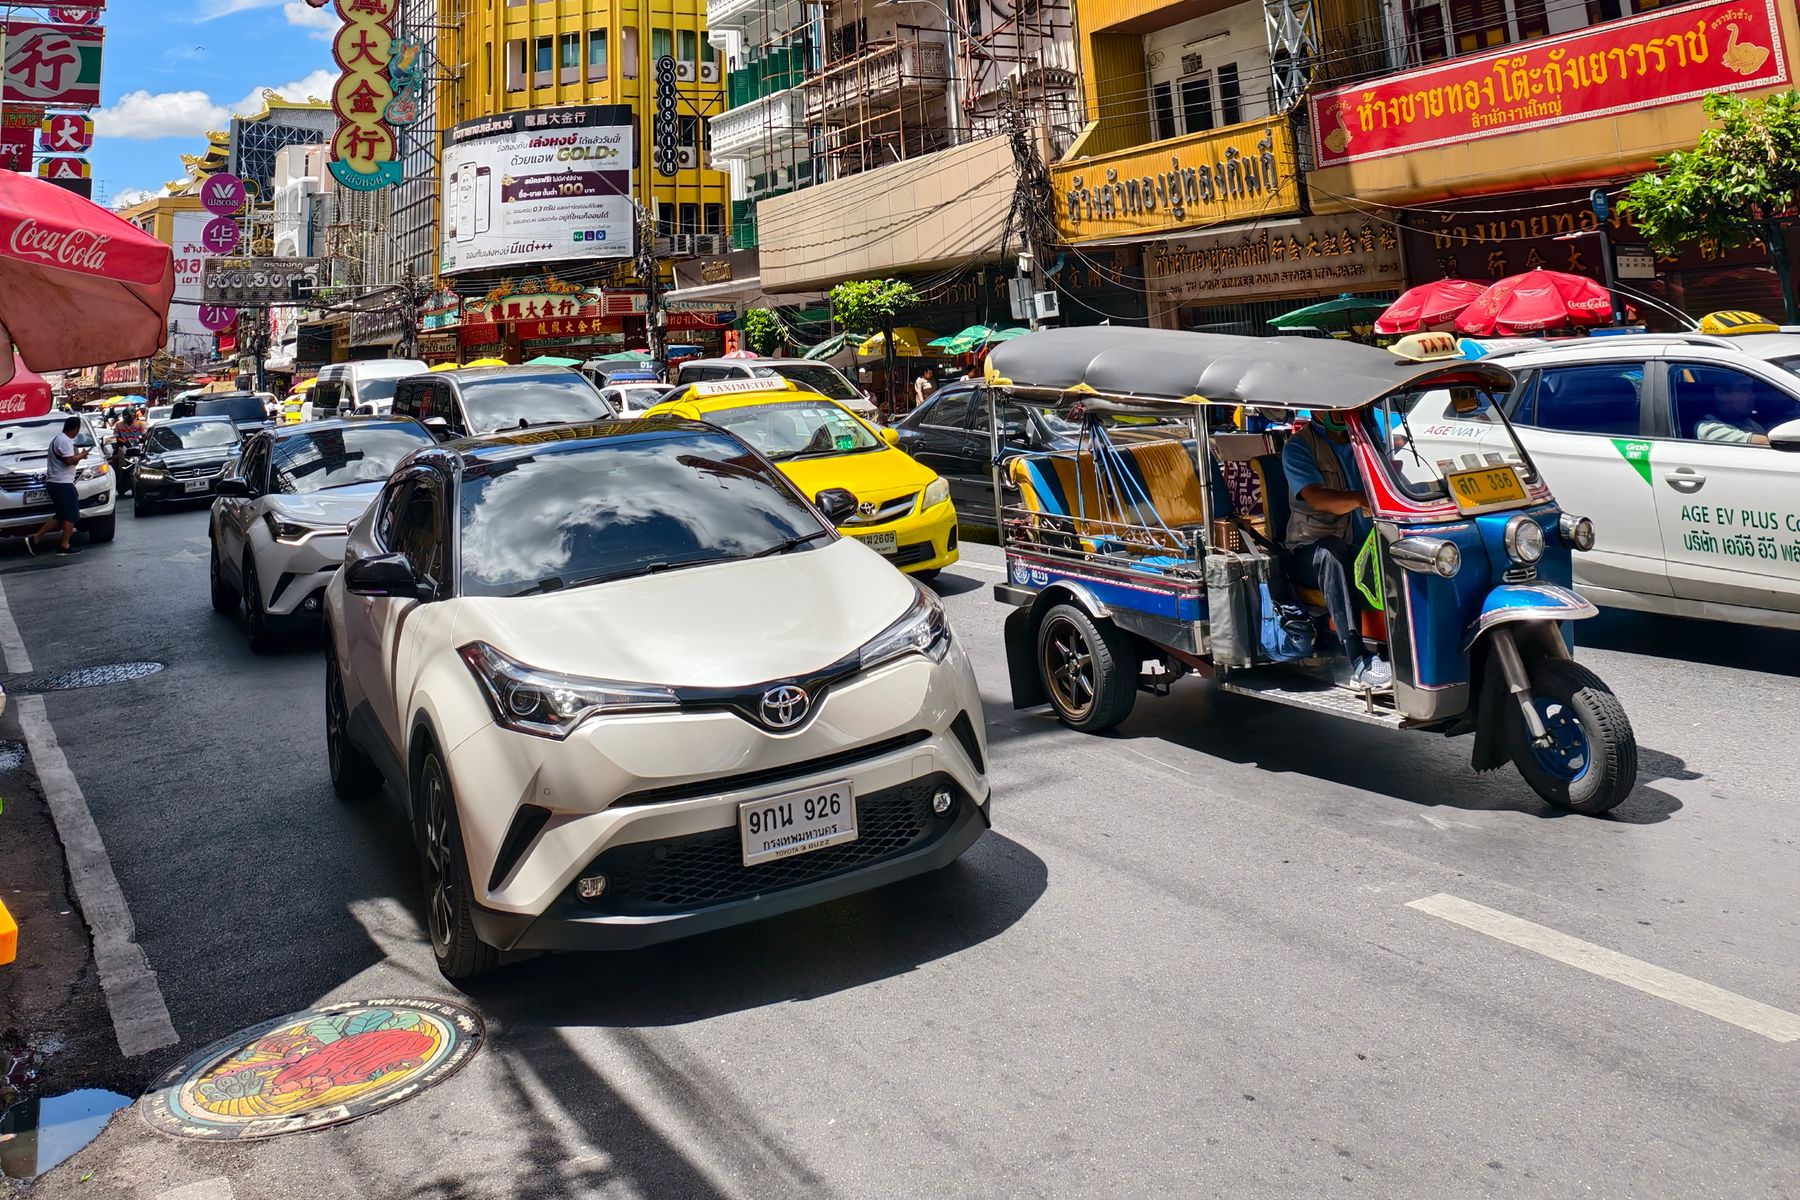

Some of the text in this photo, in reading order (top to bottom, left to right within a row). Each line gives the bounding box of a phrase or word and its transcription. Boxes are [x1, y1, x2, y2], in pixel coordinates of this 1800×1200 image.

[662, 61, 674, 172] GOLDSMITH
[1471, 95, 1562, 129] สำนักงานใหญ่
[0, 143, 23, 155] FC
[529, 133, 578, 148] เล่งหงษ์
[511, 146, 619, 166] ด้วยแอพ GOLD+
[1067, 127, 1279, 224] ห้างค้าทองยู่หลงกิมกี่
[558, 183, 584, 195] 100
[10, 218, 112, 271] Coca-Cola
[1281, 269, 1312, 282] STORE
[1567, 297, 1611, 311] Coca-Cola
[1417, 336, 1456, 354] TAXI
[707, 379, 777, 394] TAXIMETER
[1423, 424, 1484, 438] AGEWAY
[1625, 442, 1649, 451] Grab
[1485, 472, 1514, 491] 336
[1681, 504, 1710, 524] AGE
[1716, 507, 1735, 526] EV
[1741, 509, 1779, 531] PLUS
[1683, 530, 1718, 554] บริษัท
[1722, 533, 1756, 557] เอจีอี
[1757, 537, 1778, 561] อีวี
[750, 792, 841, 834] 9กน 926
[775, 839, 831, 857] TOYOTA BUZZ
